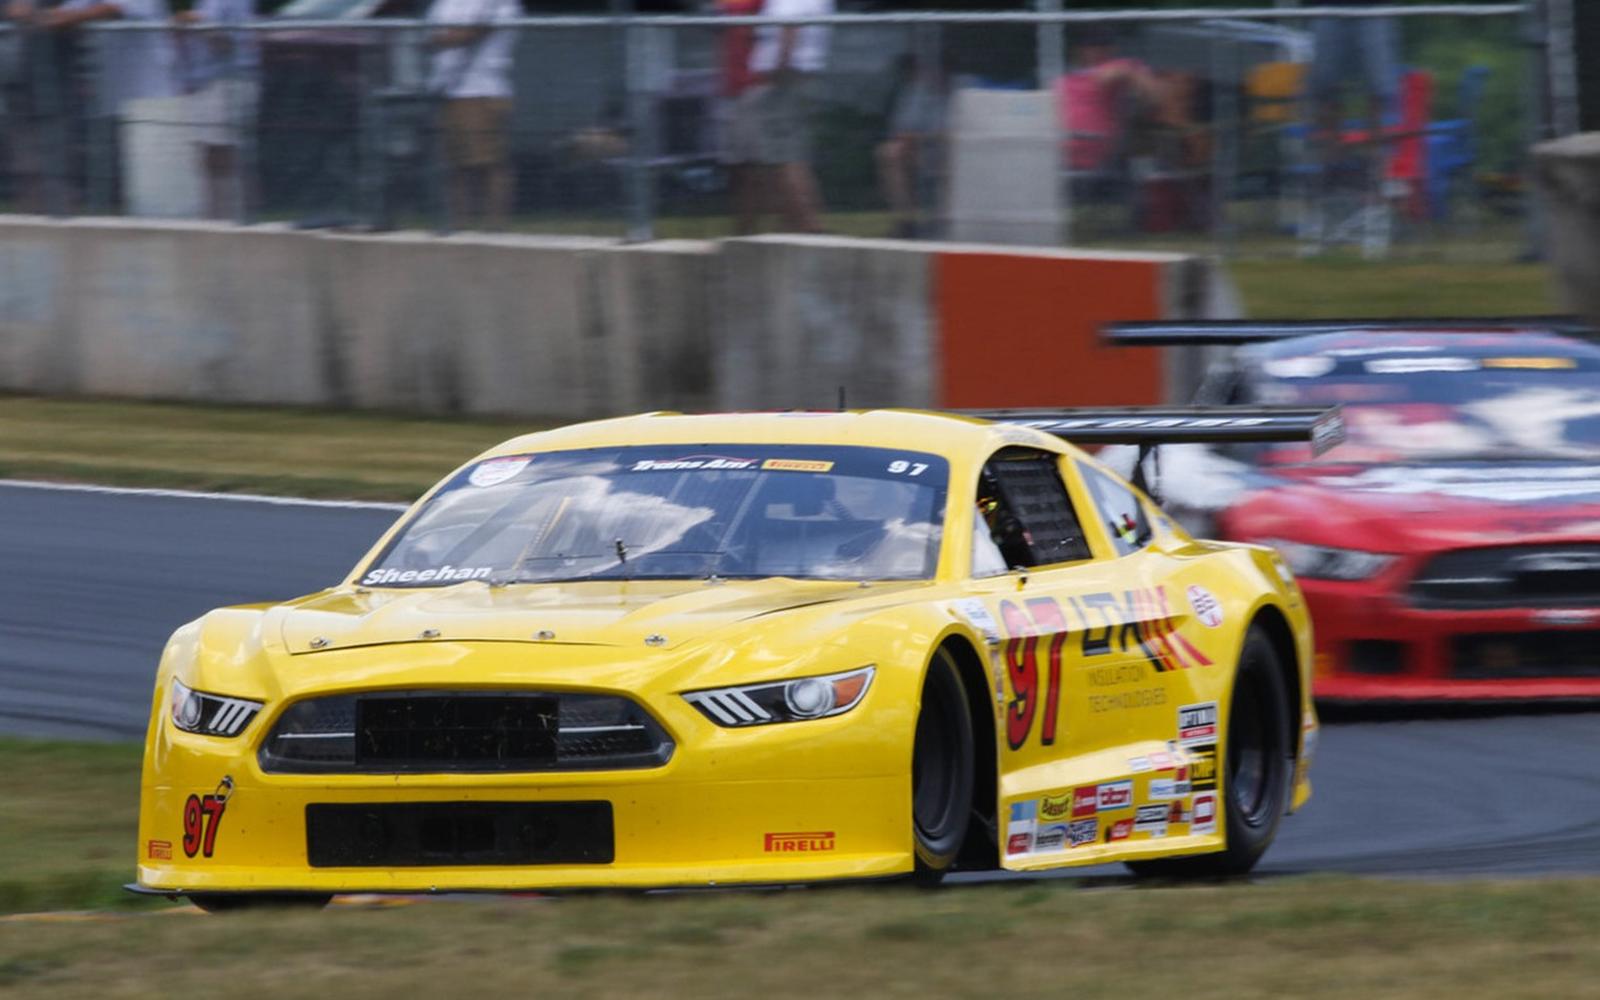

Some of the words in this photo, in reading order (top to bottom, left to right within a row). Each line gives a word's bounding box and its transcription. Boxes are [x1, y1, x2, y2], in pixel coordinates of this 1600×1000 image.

[632, 458, 701, 472] Trans
[886, 459, 928, 477] 97
[364, 565, 492, 585] Sheehan
[1000, 597, 1068, 751] 97
[183, 793, 226, 858] 97
[764, 831, 836, 852] PIRELLI
